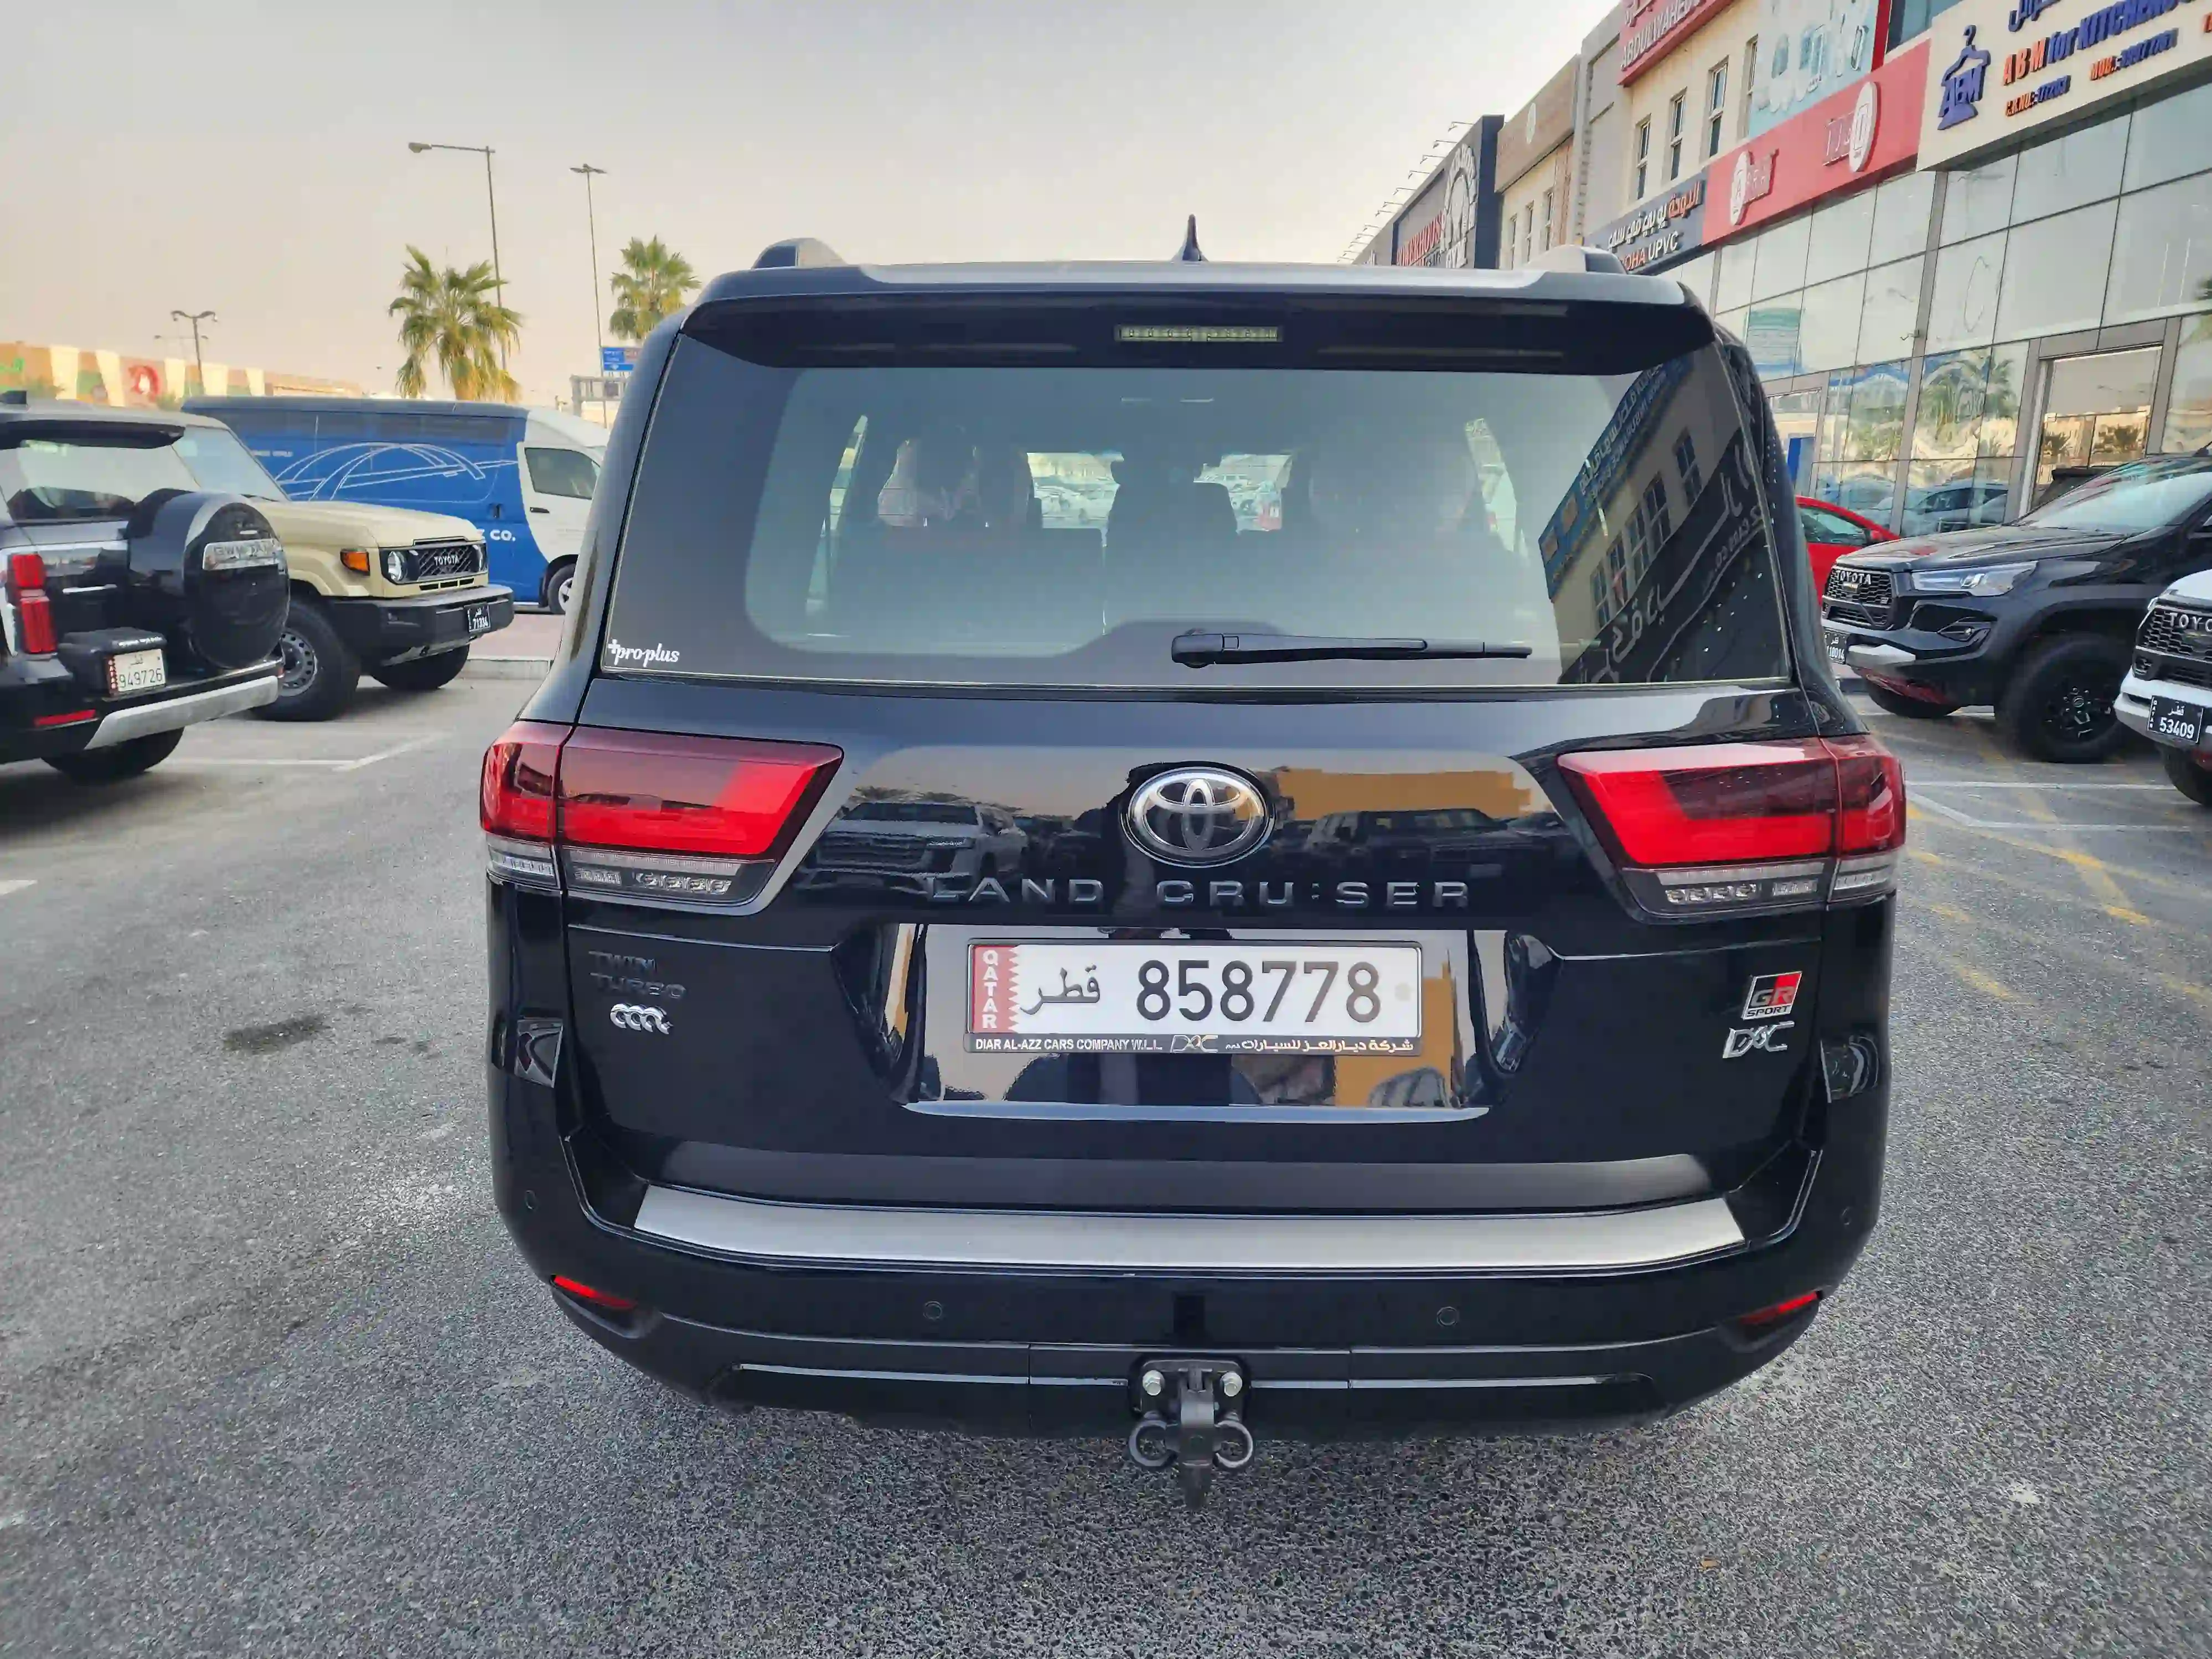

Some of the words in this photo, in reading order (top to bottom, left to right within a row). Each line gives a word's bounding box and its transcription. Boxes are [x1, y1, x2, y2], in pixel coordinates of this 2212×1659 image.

[1647, 230, 1679, 260] UPVC
[490, 529, 516, 542] CO.
[434, 553, 459, 566] TOYOTA
[1836, 570, 1872, 585] TOYOTA
[119, 668, 163, 688] 949726
[2168, 705, 2185, 716] قطر
[2159, 717, 2195, 740] 53409
[923, 876, 1104, 905] LAND
[1156, 880, 1470, 908] CRUISER
[588, 950, 657, 972] TWIN
[590, 972, 686, 999] TURBO
[983, 950, 998, 1029] QATAR
[1020, 964, 1100, 1015] قطر
[1136, 959, 1381, 1024] 858778
[1749, 987, 1796, 1007] GR
[1746, 1006, 1790, 1017] SPORT
[976, 1039, 1001, 1050] DIAR
[1004, 1039, 1042, 1050] AL-AZZ
[1043, 1039, 1074, 1050] CARS
[1077, 1039, 1129, 1050] COMPANY
[1242, 1038, 1301, 1053] للسيارات
[1368, 1038, 1414, 1053] شركة
